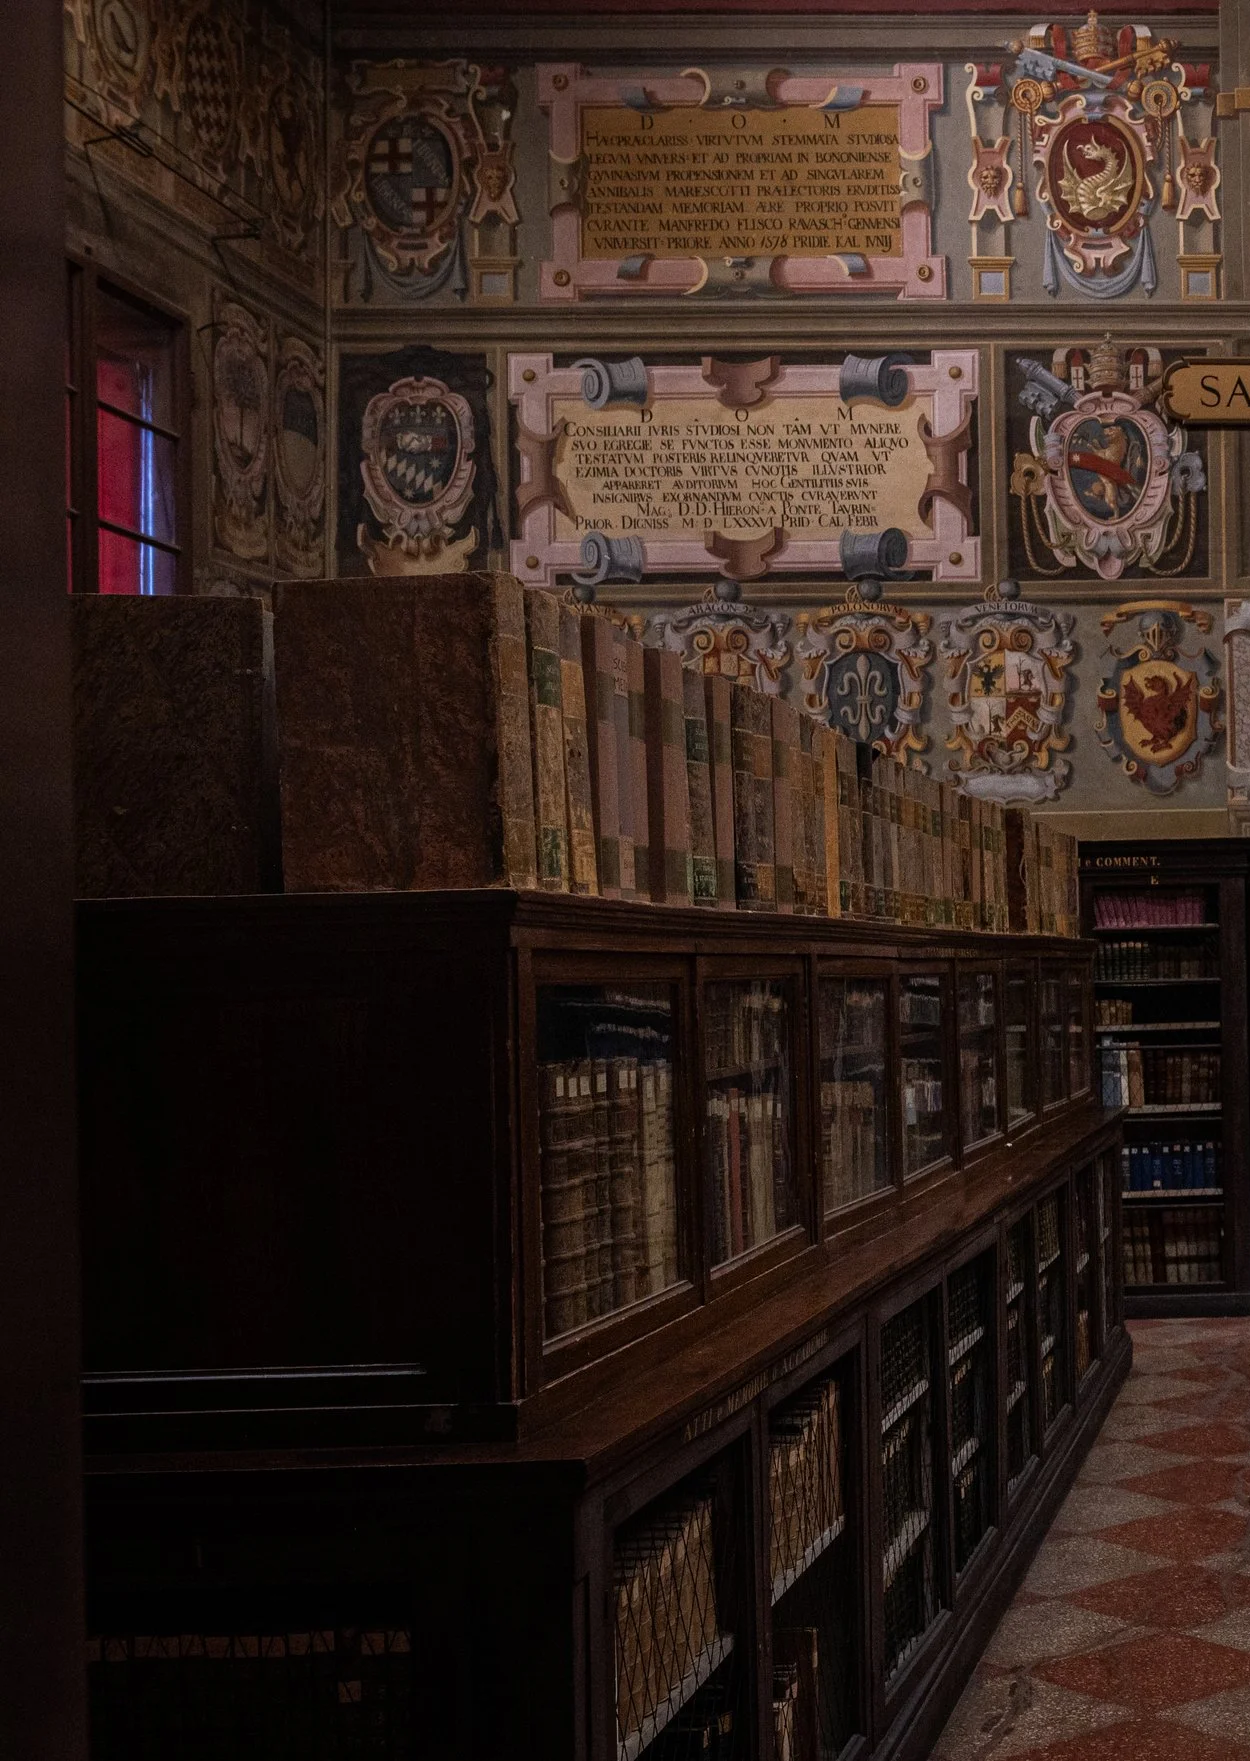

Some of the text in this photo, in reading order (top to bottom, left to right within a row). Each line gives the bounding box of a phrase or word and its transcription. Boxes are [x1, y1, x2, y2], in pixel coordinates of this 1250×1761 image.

[641, 113, 841, 130] D O M
[772, 134, 839, 146] STEMMATA
[713, 152, 729, 164] AD
[781, 170, 798, 180] AD
[806, 169, 884, 180] SINGVLAREM
[719, 236, 755, 248] ANNO
[761, 234, 788, 250] 1578
[641, 407, 854, 424] D O M
[686, 425, 740, 436] STVDIOSI
[747, 424, 775, 436] NON
[782, 424, 811, 436] TAM
[819, 424, 841, 435] VT
[850, 424, 902, 435] MVNERE
[571, 440, 597, 451] SVO
[660, 440, 675, 451] SE
[682, 439, 735, 450] FVNCTOS
[740, 439, 771, 449] ESSE
[778, 438, 853, 449] MONVMENTO
[864, 437, 909, 451] ALIQVO
[575, 453, 644, 464] TESTATVM
[653, 452, 706, 464] POSTERIS
[821, 451, 859, 464] QVAM
[871, 451, 891, 461] VT
[624, 466, 683, 477] DOCTORIS
[691, 465, 738, 477] VIRTVS
[602, 480, 661, 490] APPARERET
[751, 479, 777, 489] HOC
[845, 478, 869, 488] SVIS
[782, 500, 822, 515] PONTE
[1096, 856, 1161, 868] COMMENT.
